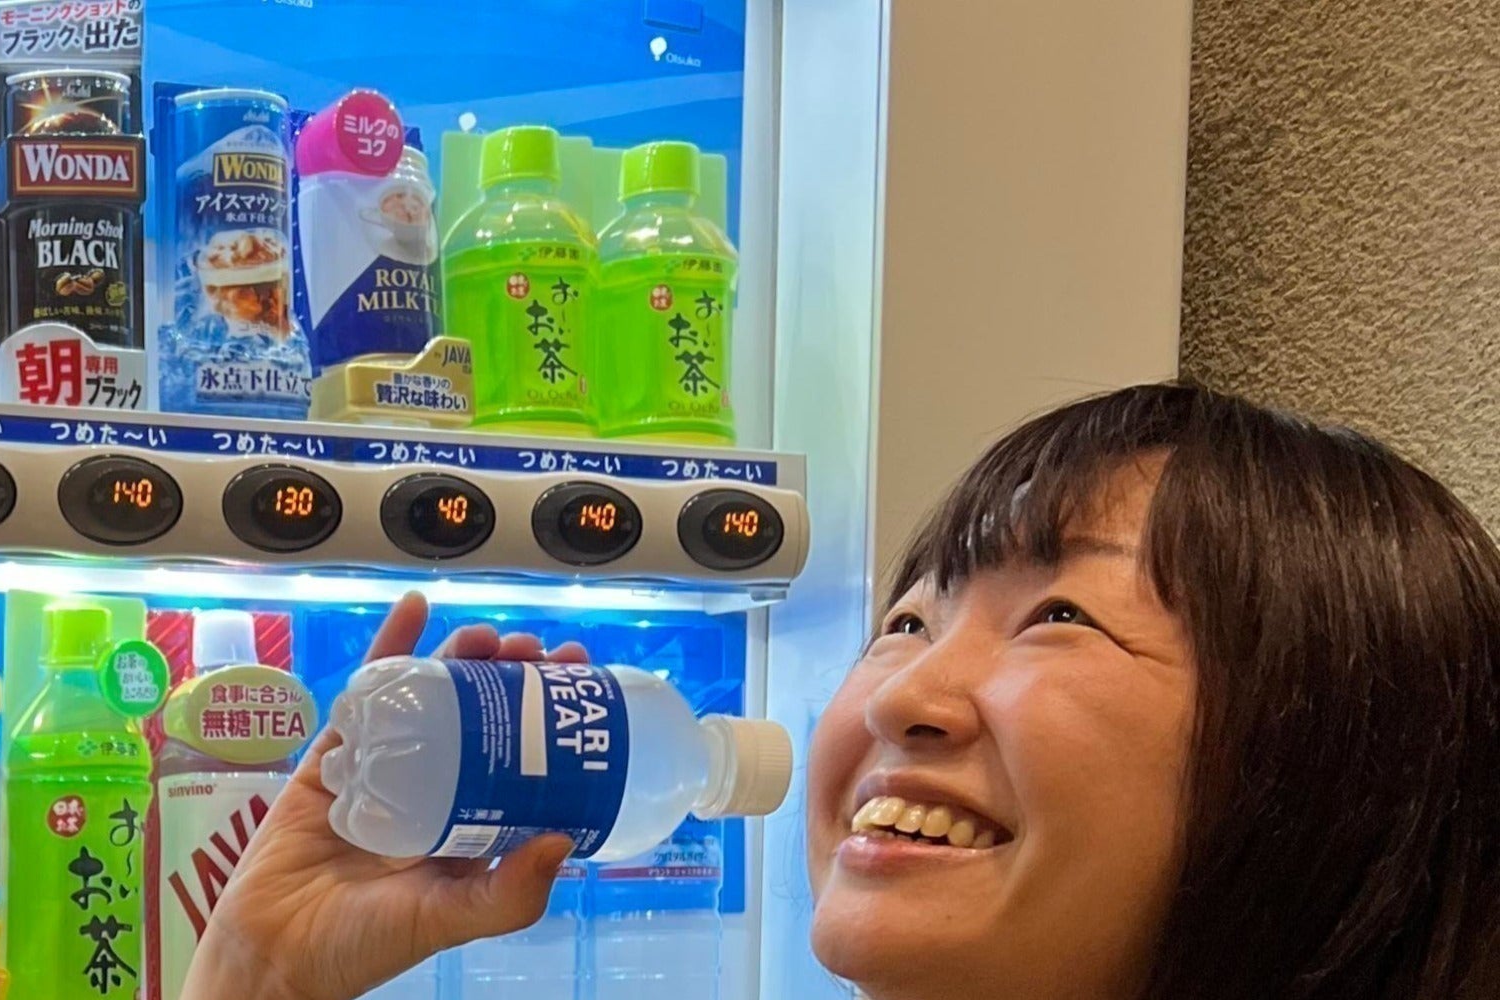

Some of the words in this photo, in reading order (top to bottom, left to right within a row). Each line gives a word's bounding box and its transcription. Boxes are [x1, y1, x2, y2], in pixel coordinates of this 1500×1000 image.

[343, 114, 400, 139] ミルクの
[357, 139, 388, 157] コク
[21, 144, 130, 183] WONDA
[28, 216, 94, 239] Morning
[37, 240, 119, 269] BLACK
[357, 292, 417, 312] MILK
[16, 339, 83, 406] 朝
[85, 355, 118, 376] 専用
[85, 376, 142, 409] ブラック
[200, 367, 312, 398] 氷点下仕立て
[376, 382, 467, 410] 贅沢な味わい
[112, 479, 152, 507] 140
[275, 487, 313, 516] 130
[580, 503, 617, 530] 140
[724, 510, 758, 536] 140
[538, 663, 583, 755] WEAT
[567, 663, 610, 771] OCARI
[202, 709, 307, 739] 無糖TEA
[68, 845, 138, 995] お茶
